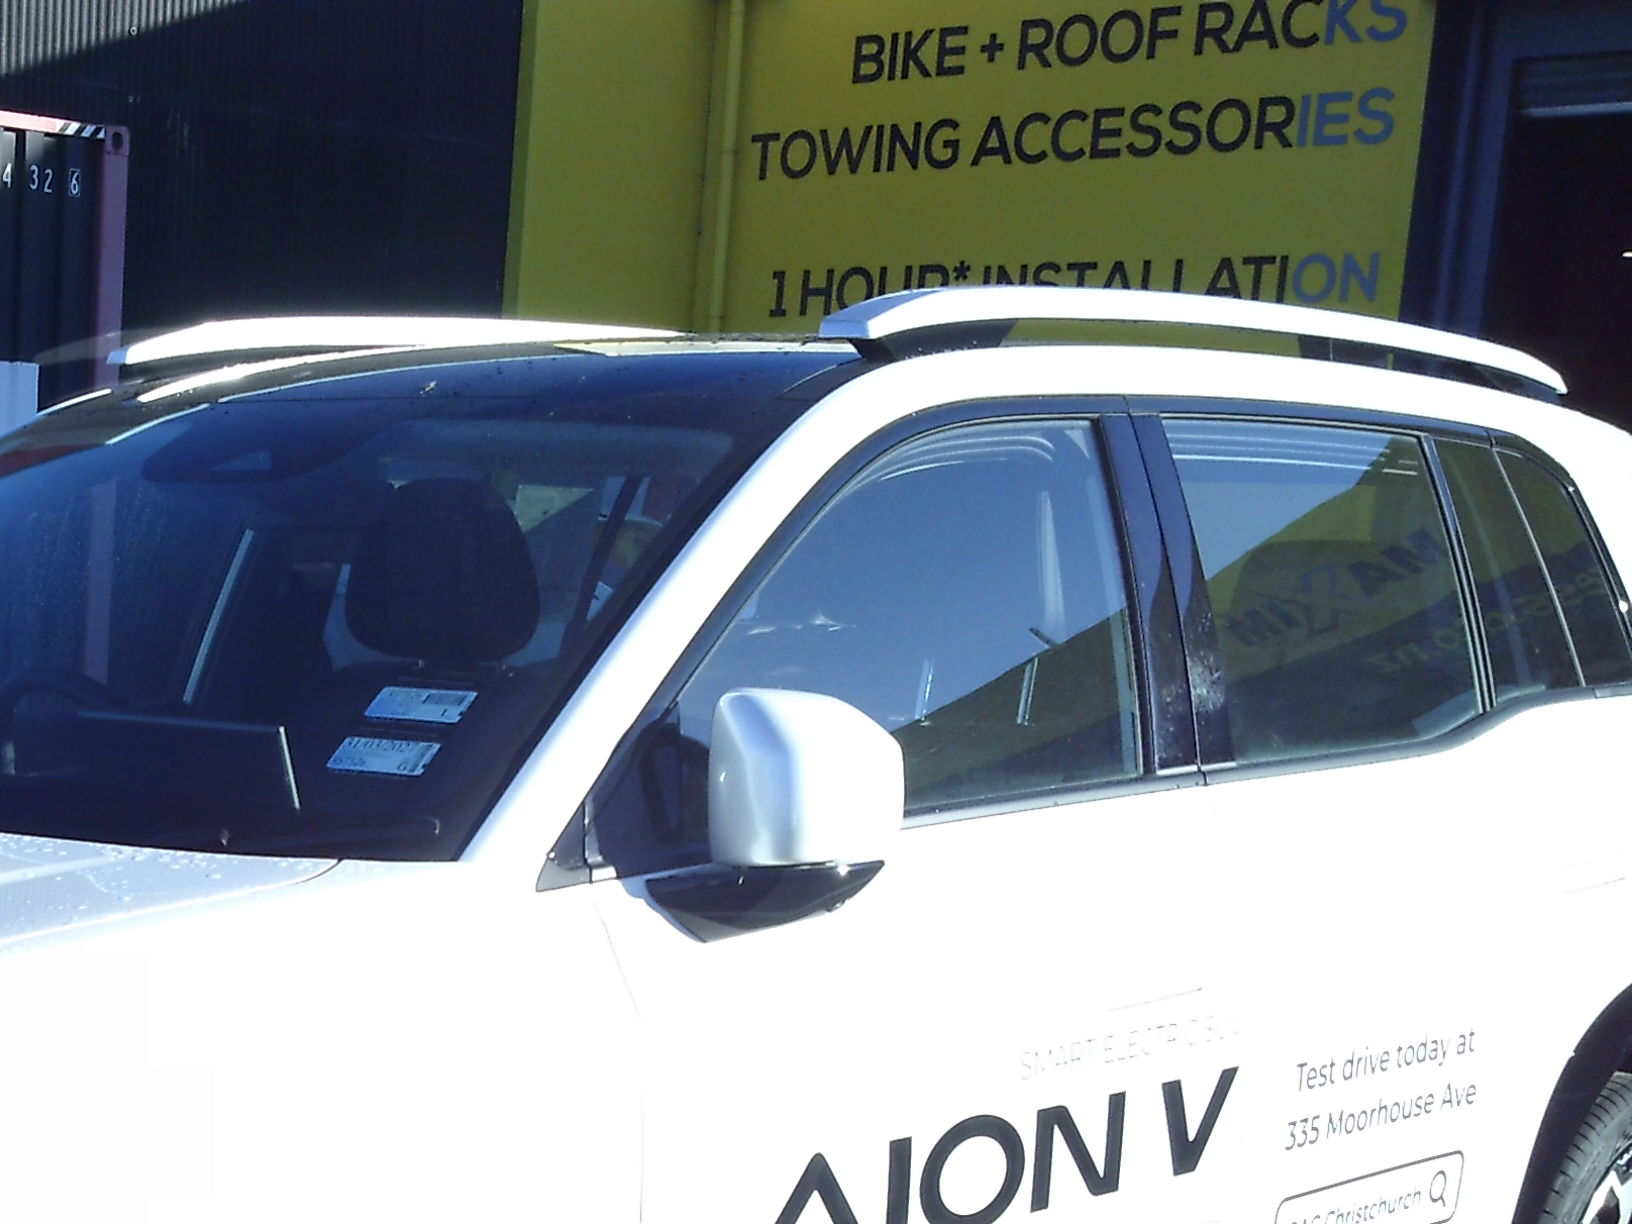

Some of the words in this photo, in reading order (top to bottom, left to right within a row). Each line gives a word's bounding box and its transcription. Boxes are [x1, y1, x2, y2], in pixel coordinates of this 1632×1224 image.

[852, 25, 968, 84] BIKE
[1017, 6, 1183, 70] ROOF
[1193, 0, 1409, 57] RACKS
[751, 117, 960, 181] TOWING
[971, 88, 1396, 167] ACCESSORIES
[769, 270, 788, 318] 1
[1297, 1057, 1336, 1091] Test
[1343, 1046, 1390, 1081] drive
[1396, 1034, 1450, 1067] today
[1456, 1028, 1476, 1055] at
[1161, 1066, 1239, 1177] V
[1284, 1115, 1321, 1150] 335
[1326, 1092, 1435, 1139] Moorhouse
[1440, 1083, 1478, 1111] Ave
